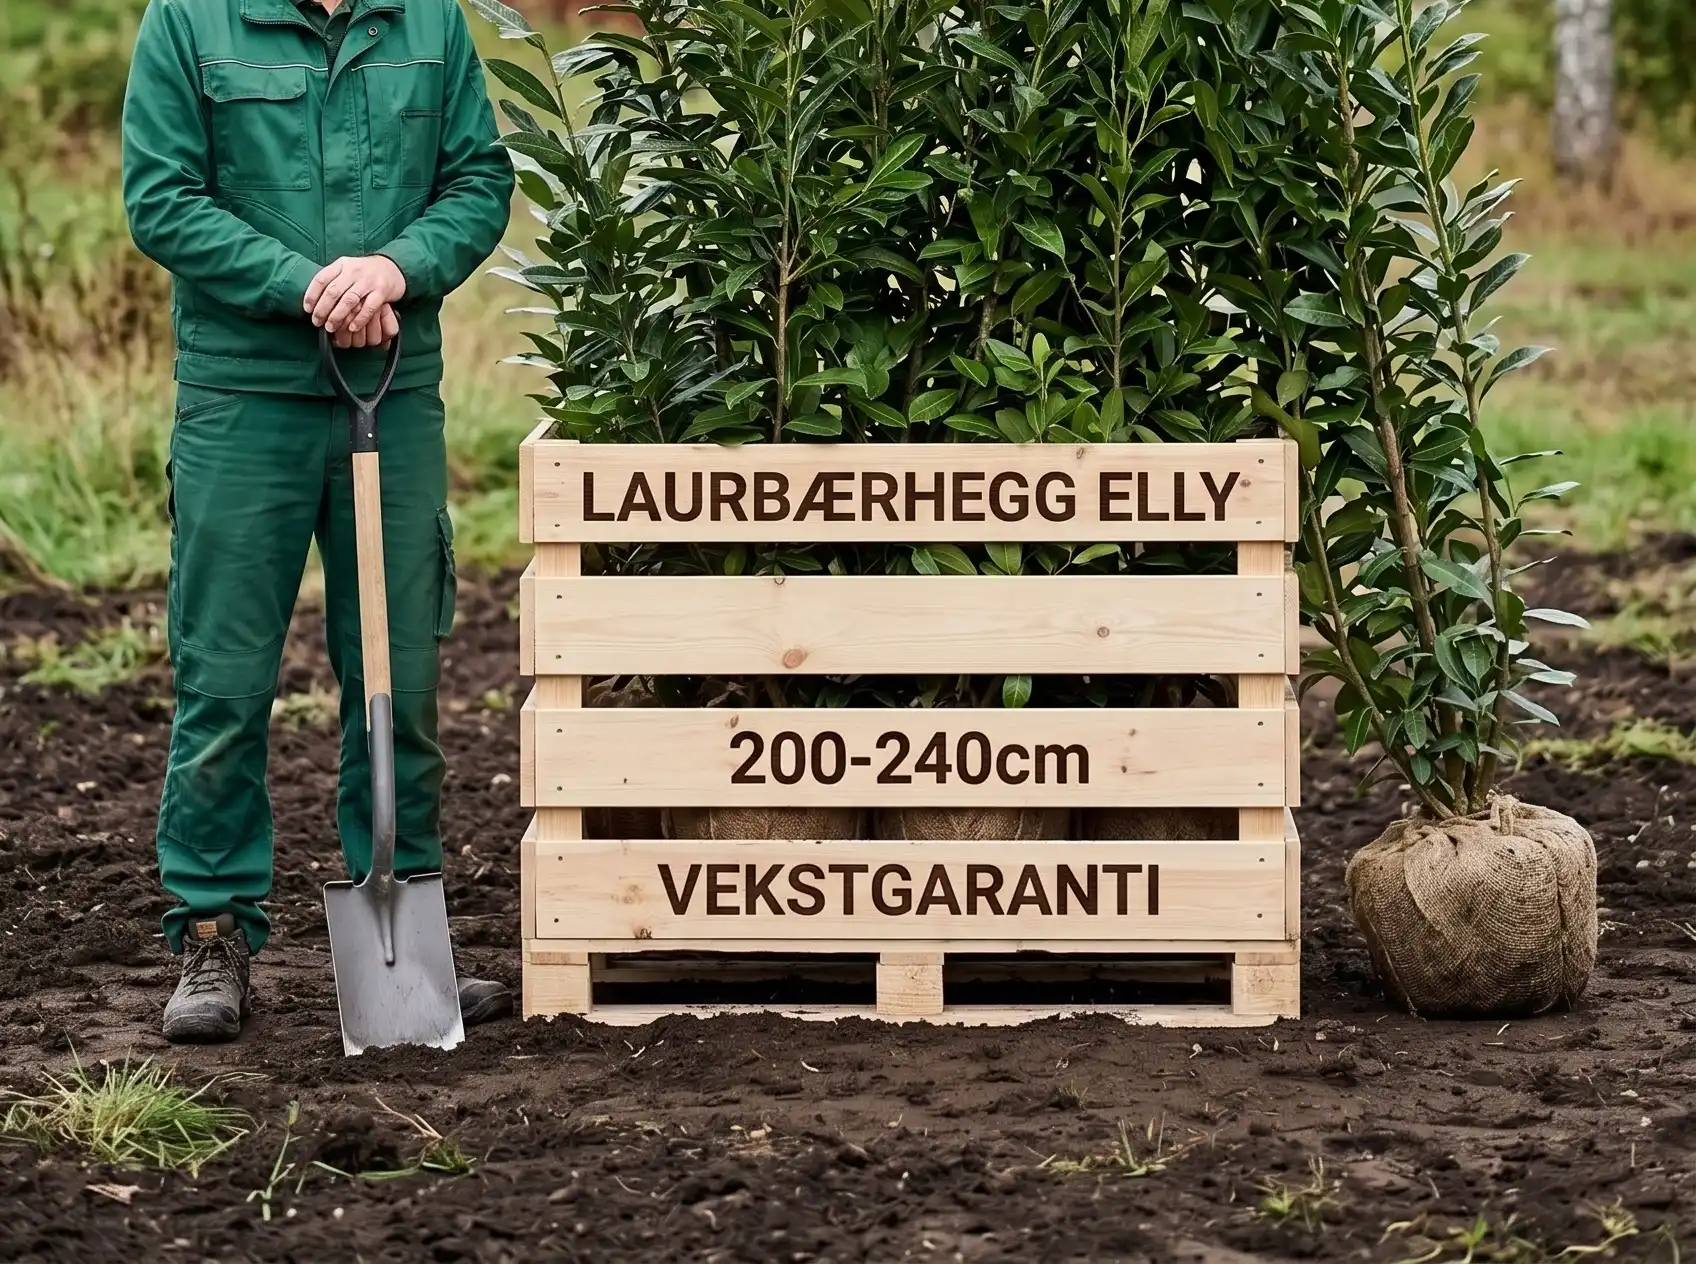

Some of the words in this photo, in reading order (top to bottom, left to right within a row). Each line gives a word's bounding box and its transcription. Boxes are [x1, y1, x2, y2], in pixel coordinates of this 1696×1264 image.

[582, 471, 1077, 523] LAURBÆRHEGG
[1099, 471, 1242, 522] ELLY
[729, 730, 1090, 785] 200-240cm
[657, 863, 1159, 916] VEKSTGARANTI
